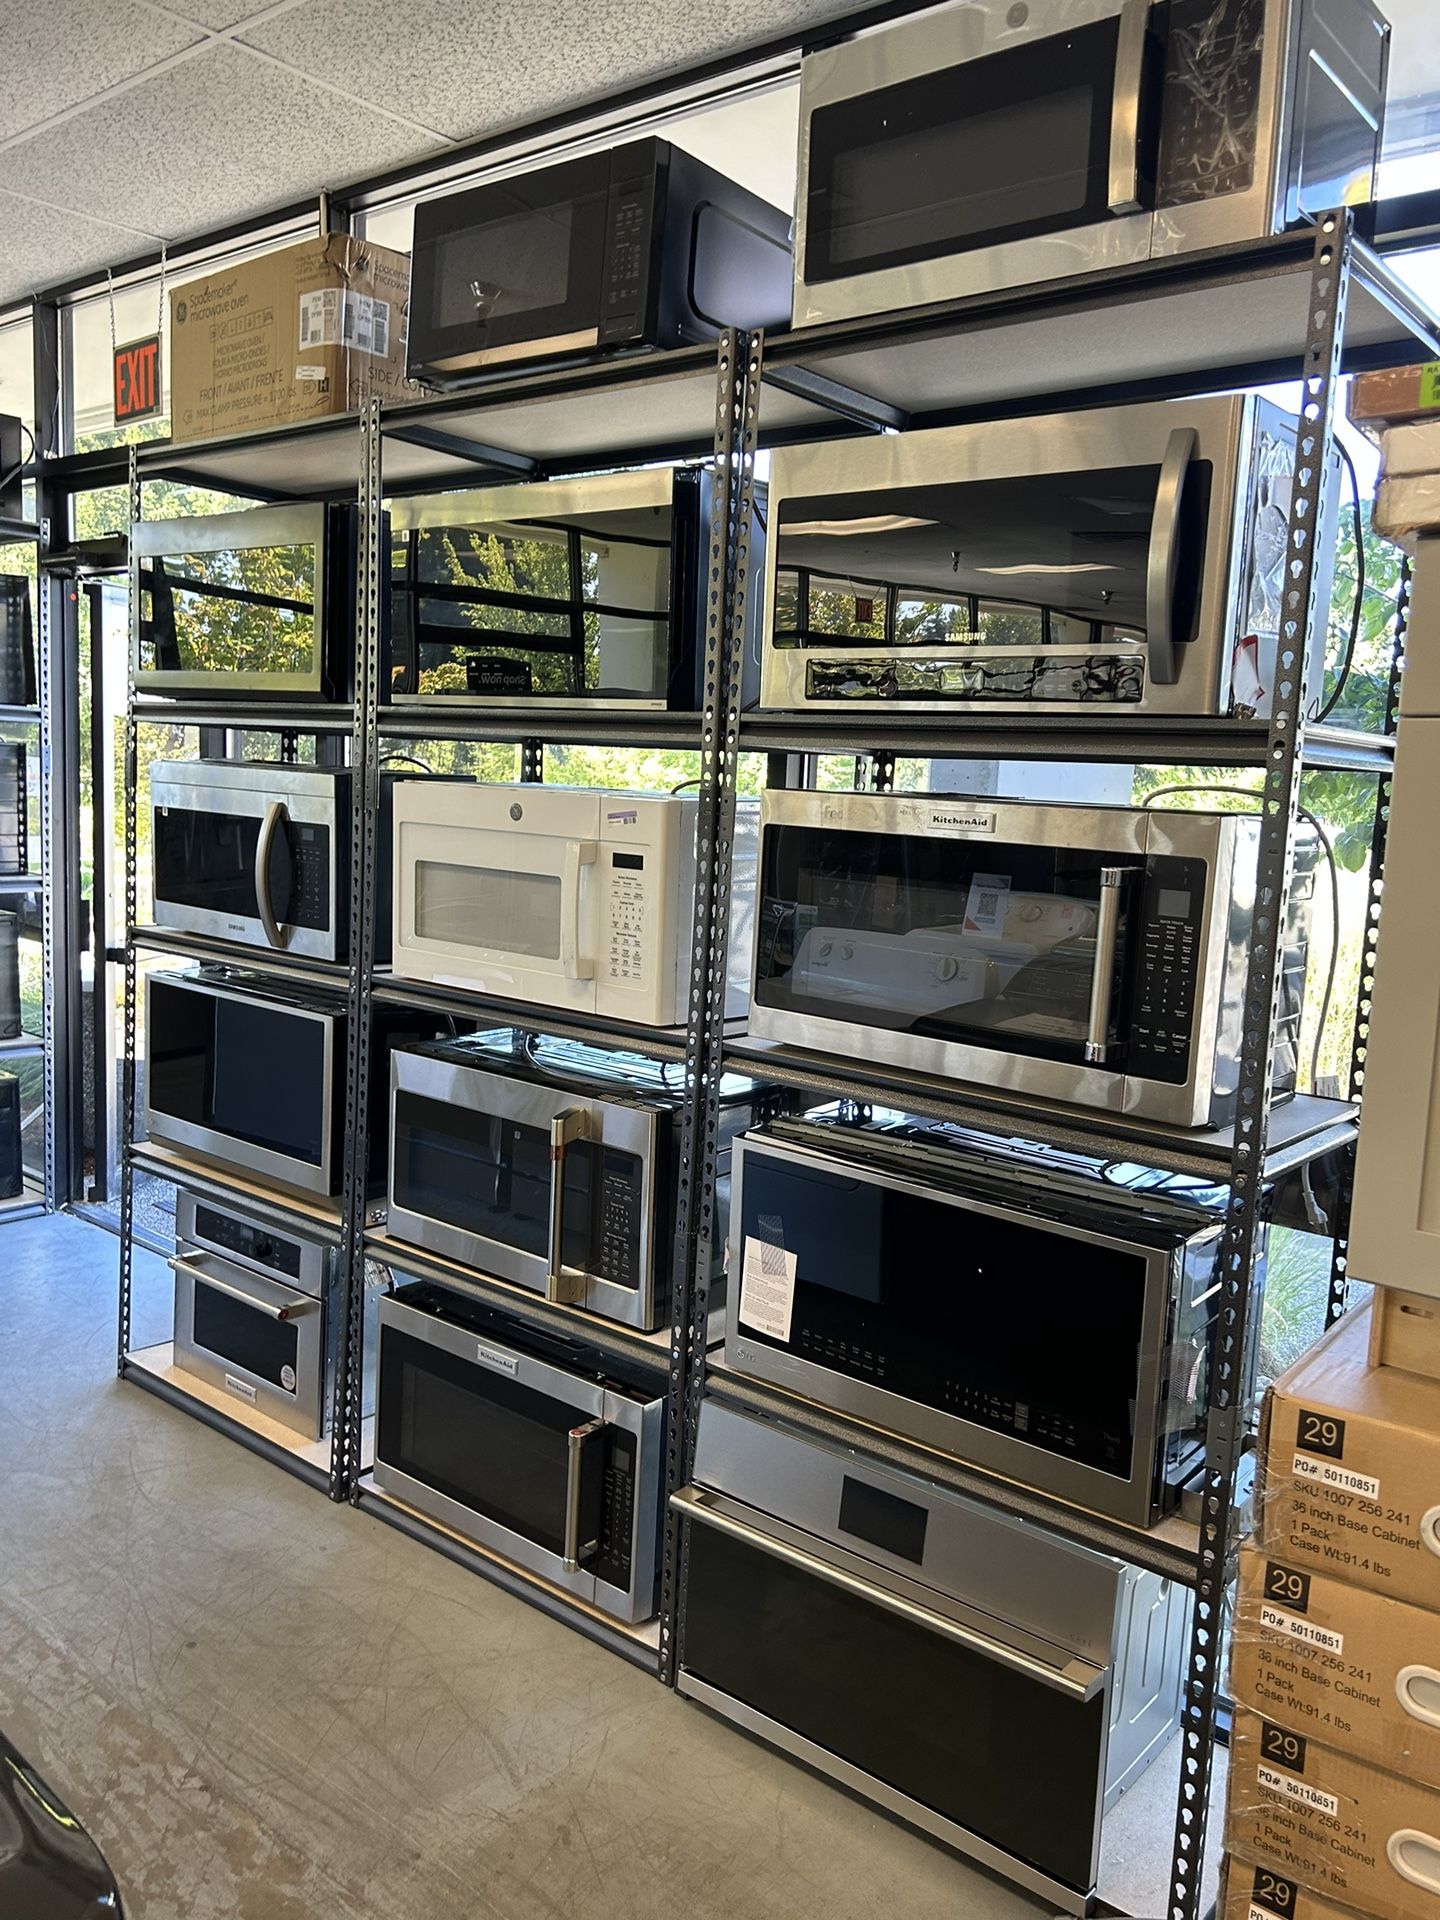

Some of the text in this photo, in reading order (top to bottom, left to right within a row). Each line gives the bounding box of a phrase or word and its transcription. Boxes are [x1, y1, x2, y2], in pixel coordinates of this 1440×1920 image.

[191, 301, 230, 322] microwave
[231, 294, 249, 311] oven
[116, 344, 157, 416] EXIT
[200, 384, 222, 402] FRONT
[256, 368, 283, 389] FRENTE
[368, 366, 392, 385] SIDE
[945, 632, 986, 642] SAMSUNG
[932, 815, 988, 827] KitchenAid
[480, 1351, 513, 1370] KitchenAid
[1304, 1416, 1337, 1446] 29
[1294, 1459, 1376, 1494] PO# 50110851
[1294, 1481, 1410, 1526] SKU 1007 256 241
[1292, 1500, 1420, 1550] 36 inch Base Cabinet
[1302, 1522, 1330, 1540] Pack
[1290, 1535, 1391, 1576] Case Wt:91.4 lbs
[1271, 1570, 1302, 1600] 29
[1262, 1610, 1339, 1648] PO# 50110851
[1258, 1648, 1381, 1708] 36 inch Base Cabinet
[1266, 1672, 1294, 1692] Pack
[1322, 1655, 1344, 1672] 256
[1348, 1666, 1372, 1683] 241
[1256, 1682, 1352, 1732] Case Wt:91.4 lbs
[1268, 1730, 1298, 1760] 29
[1259, 1770, 1334, 1810] PO# 50110851
[1257, 1788, 1366, 1843] SKU 1007 256 241
[1264, 1826, 1292, 1848] Pack
[1272, 1813, 1295, 1831] inch
[1298, 1824, 1328, 1844] Base
[1330, 1838, 1376, 1868] Cabinet
[1254, 1836, 1281, 1856] Case
[1330, 1871, 1348, 1888] lbs
[1260, 1874, 1290, 1906] 29
